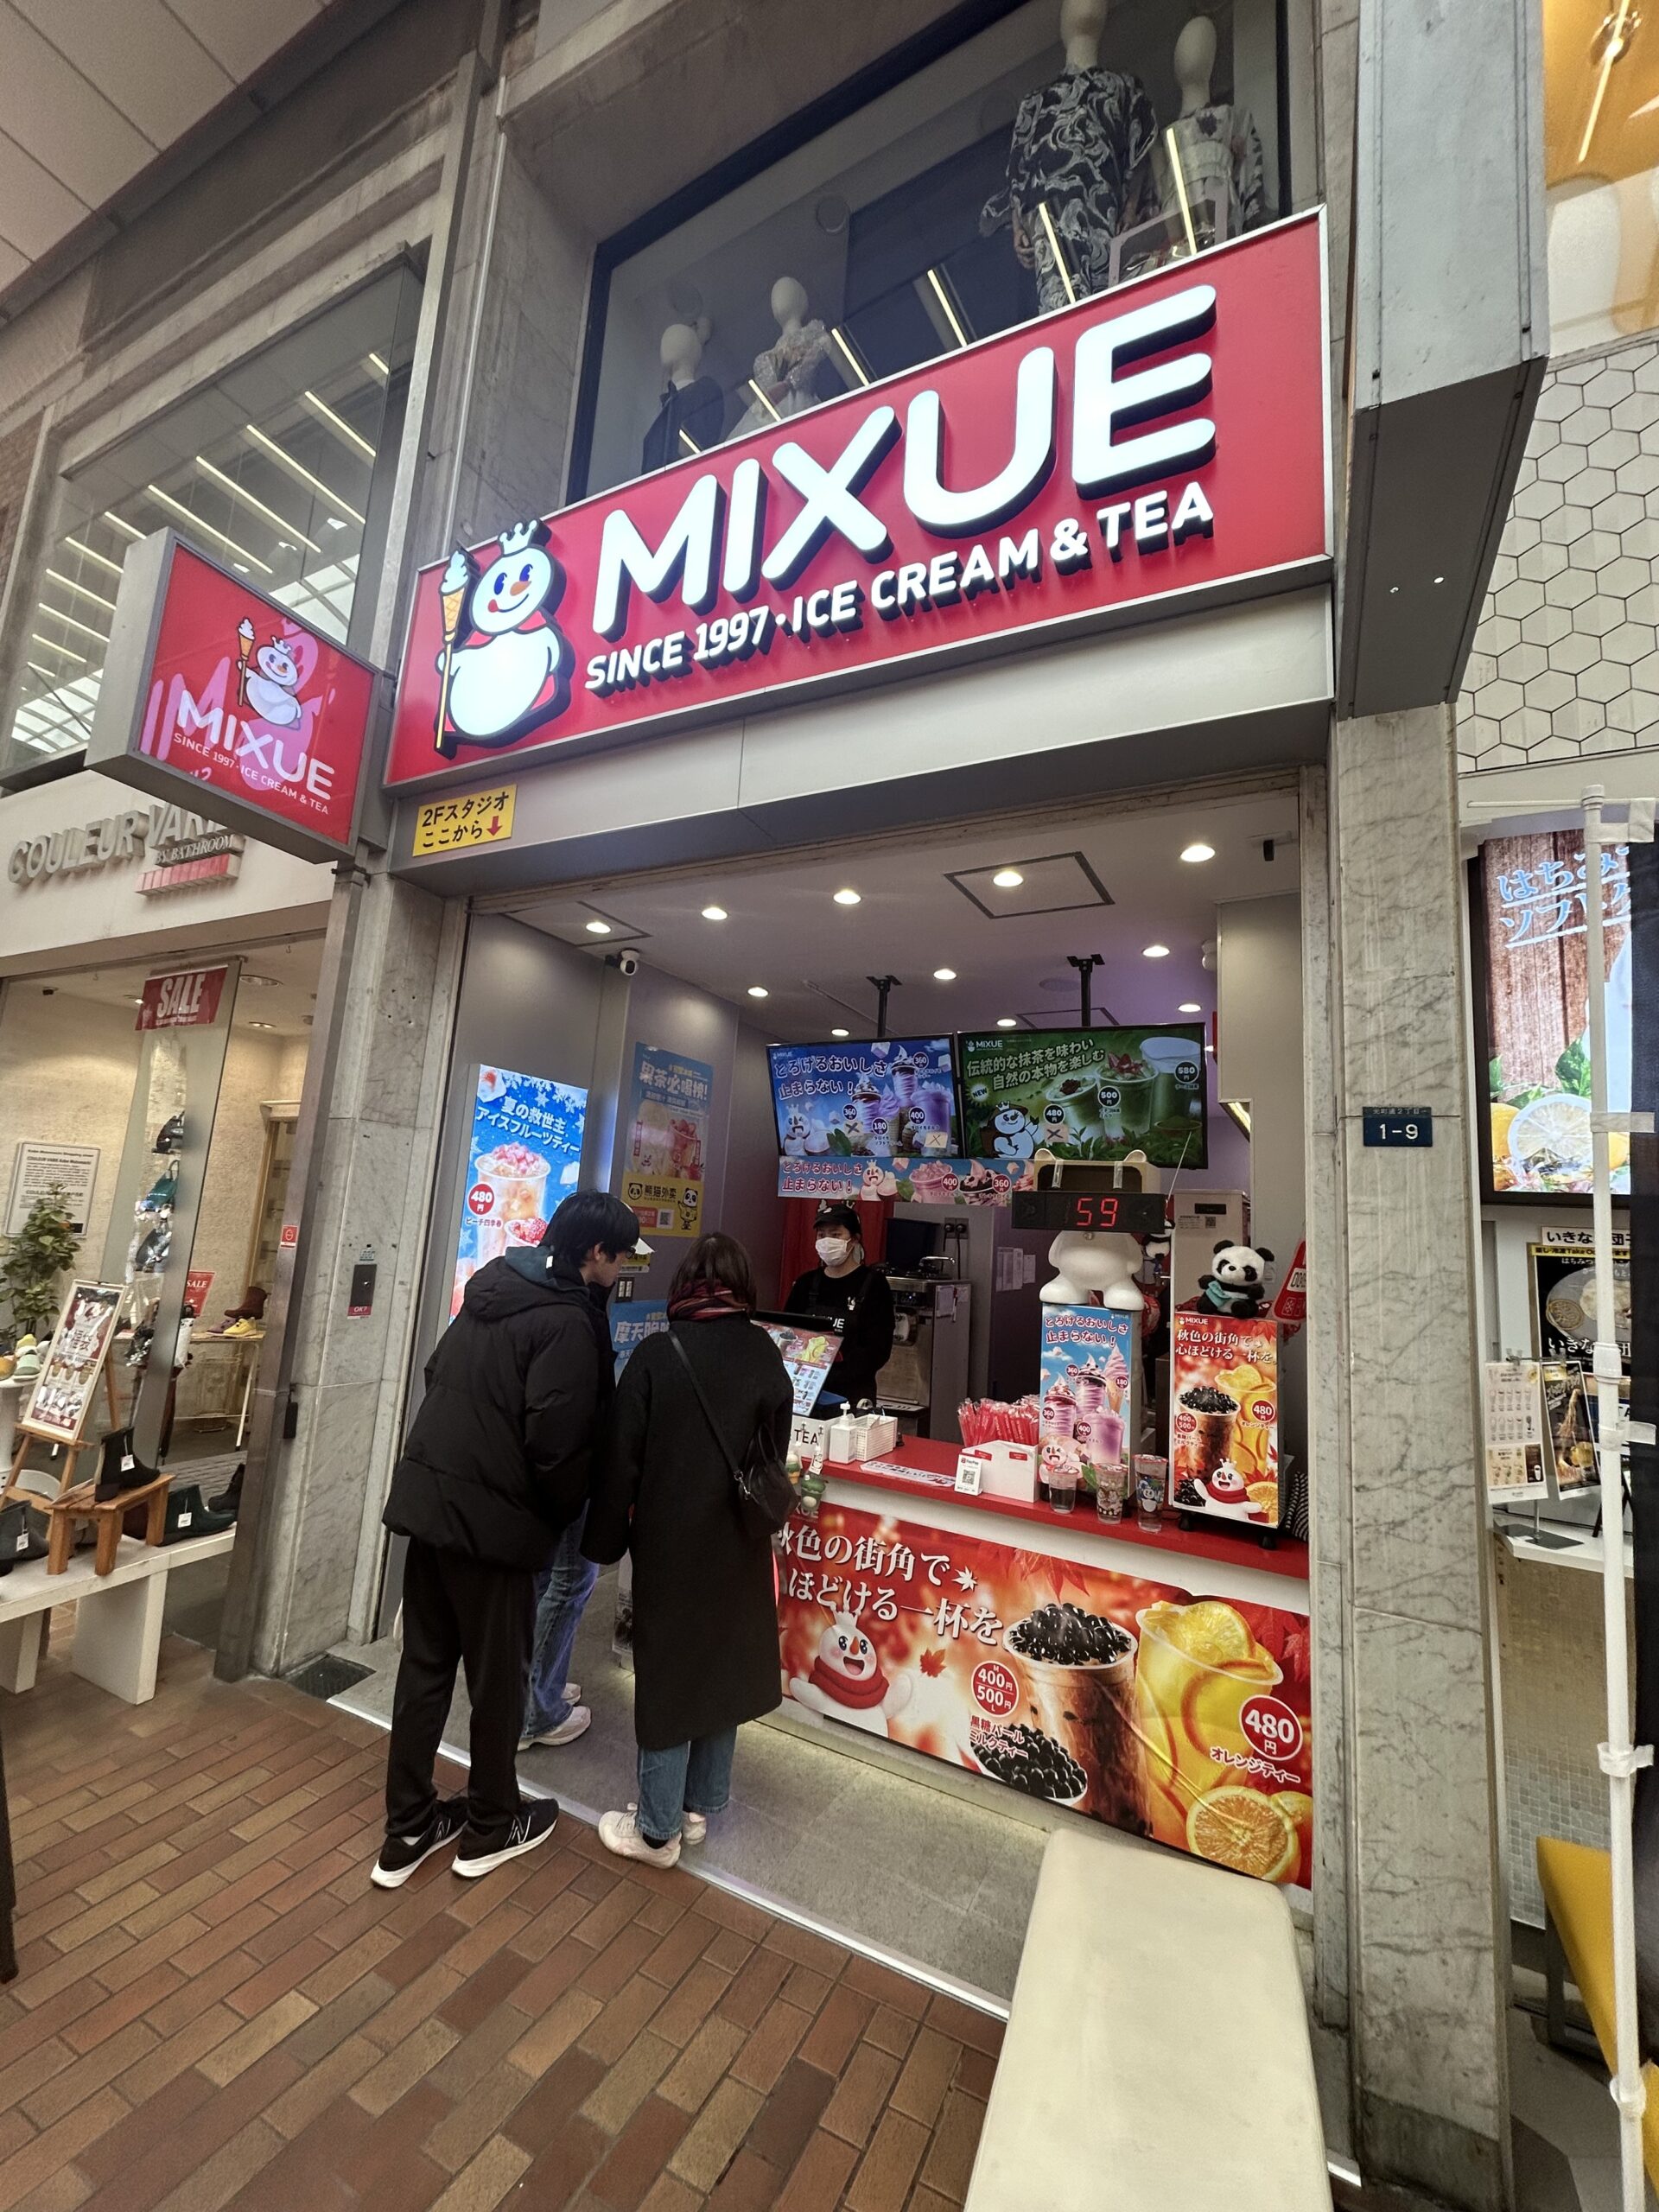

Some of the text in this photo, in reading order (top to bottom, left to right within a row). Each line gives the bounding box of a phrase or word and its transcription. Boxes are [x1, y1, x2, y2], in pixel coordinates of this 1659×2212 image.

[590, 283, 1217, 635] MIXUE
[585, 480, 1214, 690] SINCE 1997 ICE CREAM & TEA
[177, 690, 335, 801] MIXUE
[173, 733, 329, 815] SINCE 1997 ICE CREAM & TEA
[422, 791, 510, 828] 2Fスタジオ
[8, 803, 228, 884] COULEUR VAR
[423, 820, 483, 848] ここから
[171, 834, 233, 861] BATHROOM
[156, 973, 207, 1018] SALE
[976, 1039, 1003, 1048] MIXUE
[774, 1053, 888, 1078] とろけるおいしさ
[967, 1039, 1094, 1077] 伝統的な抹茶を味わい
[993, 1049, 1105, 1090] 自然の本物を楽しむ
[779, 1078, 855, 1100] 止まらない！
[972, 1087, 988, 1097] NEW
[475, 1106, 580, 1153] アイスフルーツティー
[1379, 1123, 1419, 1140] 1-9
[782, 1161, 863, 1175] とろけるおいしさ
[645, 1185, 677, 1198] 熊猫外卖
[781, 1176, 853, 1193] 止まらない！
[943, 1178, 957, 1186] 400
[994, 1179, 1008, 1188] 360
[470, 1191, 493, 1203] 480
[1077, 1198, 1118, 1227] 59
[1547, 1231, 1630, 1245] いきな団
[187, 1280, 208, 1288] SALE
[1045, 1316, 1128, 1335] とろけるおいしさ
[1046, 1331, 1116, 1348] 止まらない！
[1177, 1330, 1253, 1346] 秋色の街角で
[1548, 1338, 1630, 1357] いきな団
[1254, 1405, 1273, 1415] 480
[1242, 1421, 1274, 1430] オレンジティー
[794, 1429, 819, 1446] TEA
[778, 1522, 950, 1586] 秋色の街角で
[978, 1669, 1013, 1691] 400円
[977, 1685, 1012, 1709] 500円
[970, 1715, 1025, 1744] 黒糖パール
[1245, 1709, 1294, 1744] 480
[969, 1730, 1029, 1758] ミルクティー
[1265, 1739, 1277, 1755] 円
[1210, 1746, 1301, 1783] オレンジティー
